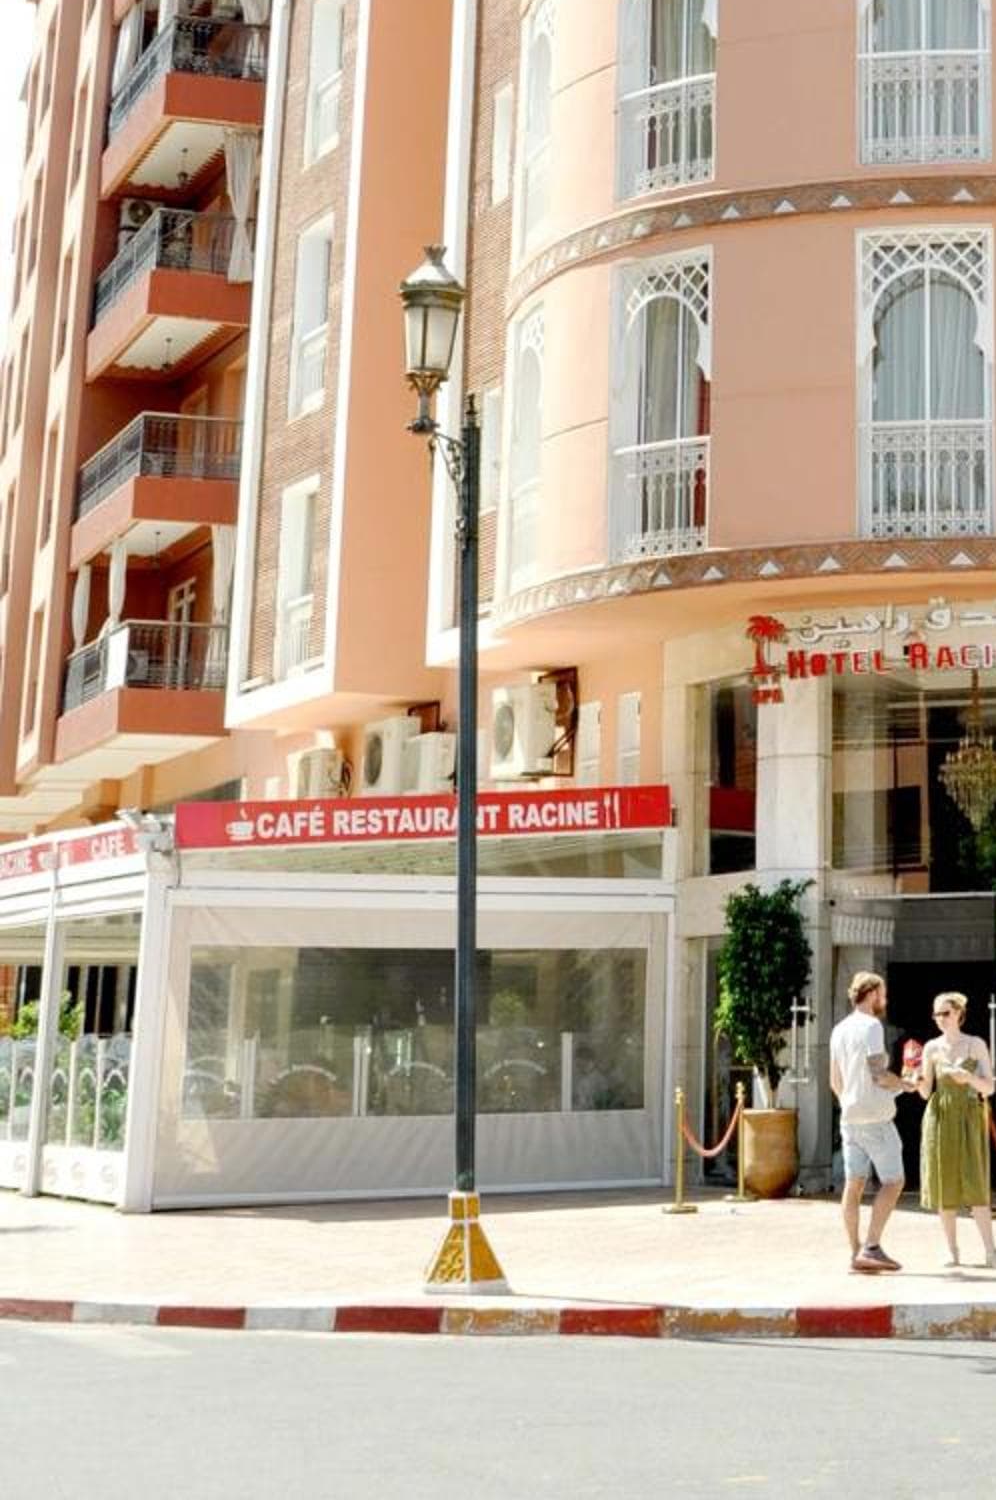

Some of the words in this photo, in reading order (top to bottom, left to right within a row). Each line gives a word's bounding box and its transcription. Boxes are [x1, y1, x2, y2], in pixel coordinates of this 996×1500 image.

[787, 650, 893, 679] HOTEL
[256, 805, 326, 838] CAFÉ
[508, 800, 599, 829] RACINE
